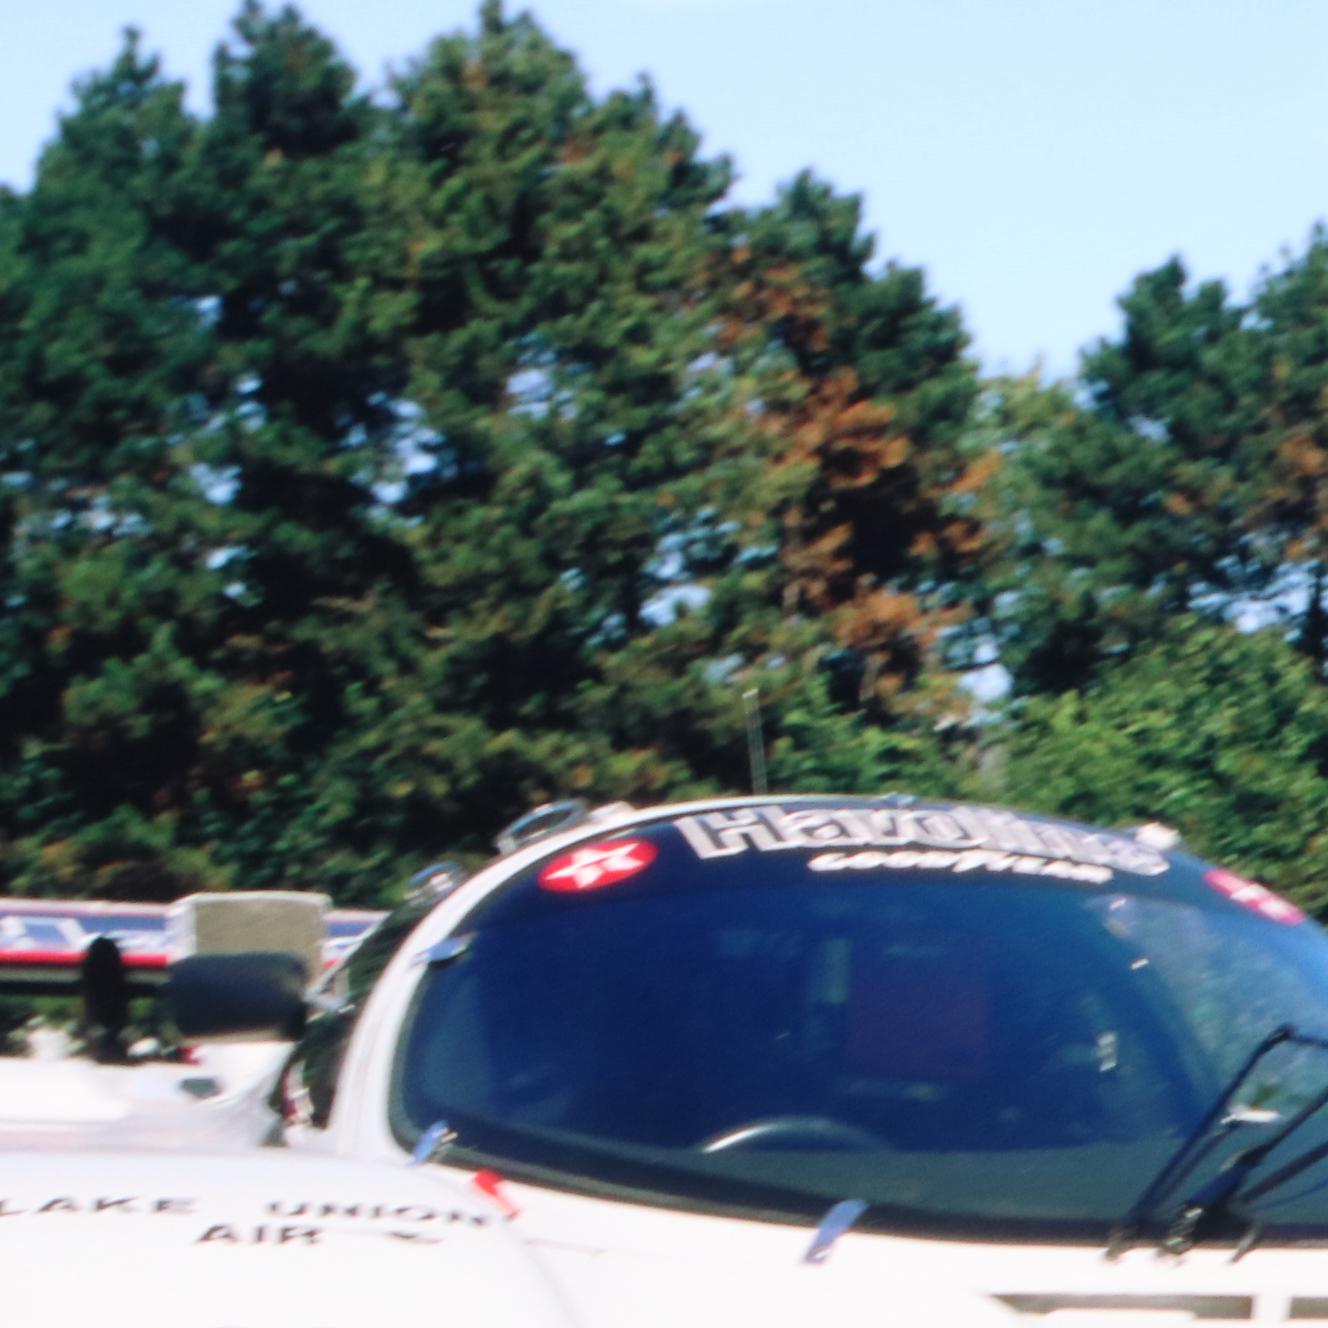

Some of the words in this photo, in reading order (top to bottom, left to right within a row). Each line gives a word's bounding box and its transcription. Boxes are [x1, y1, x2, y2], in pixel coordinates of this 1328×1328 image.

[672, 804, 1171, 877] Havolin
[266, 1199, 490, 1229] UNION
[197, 1222, 325, 1245] AIR
